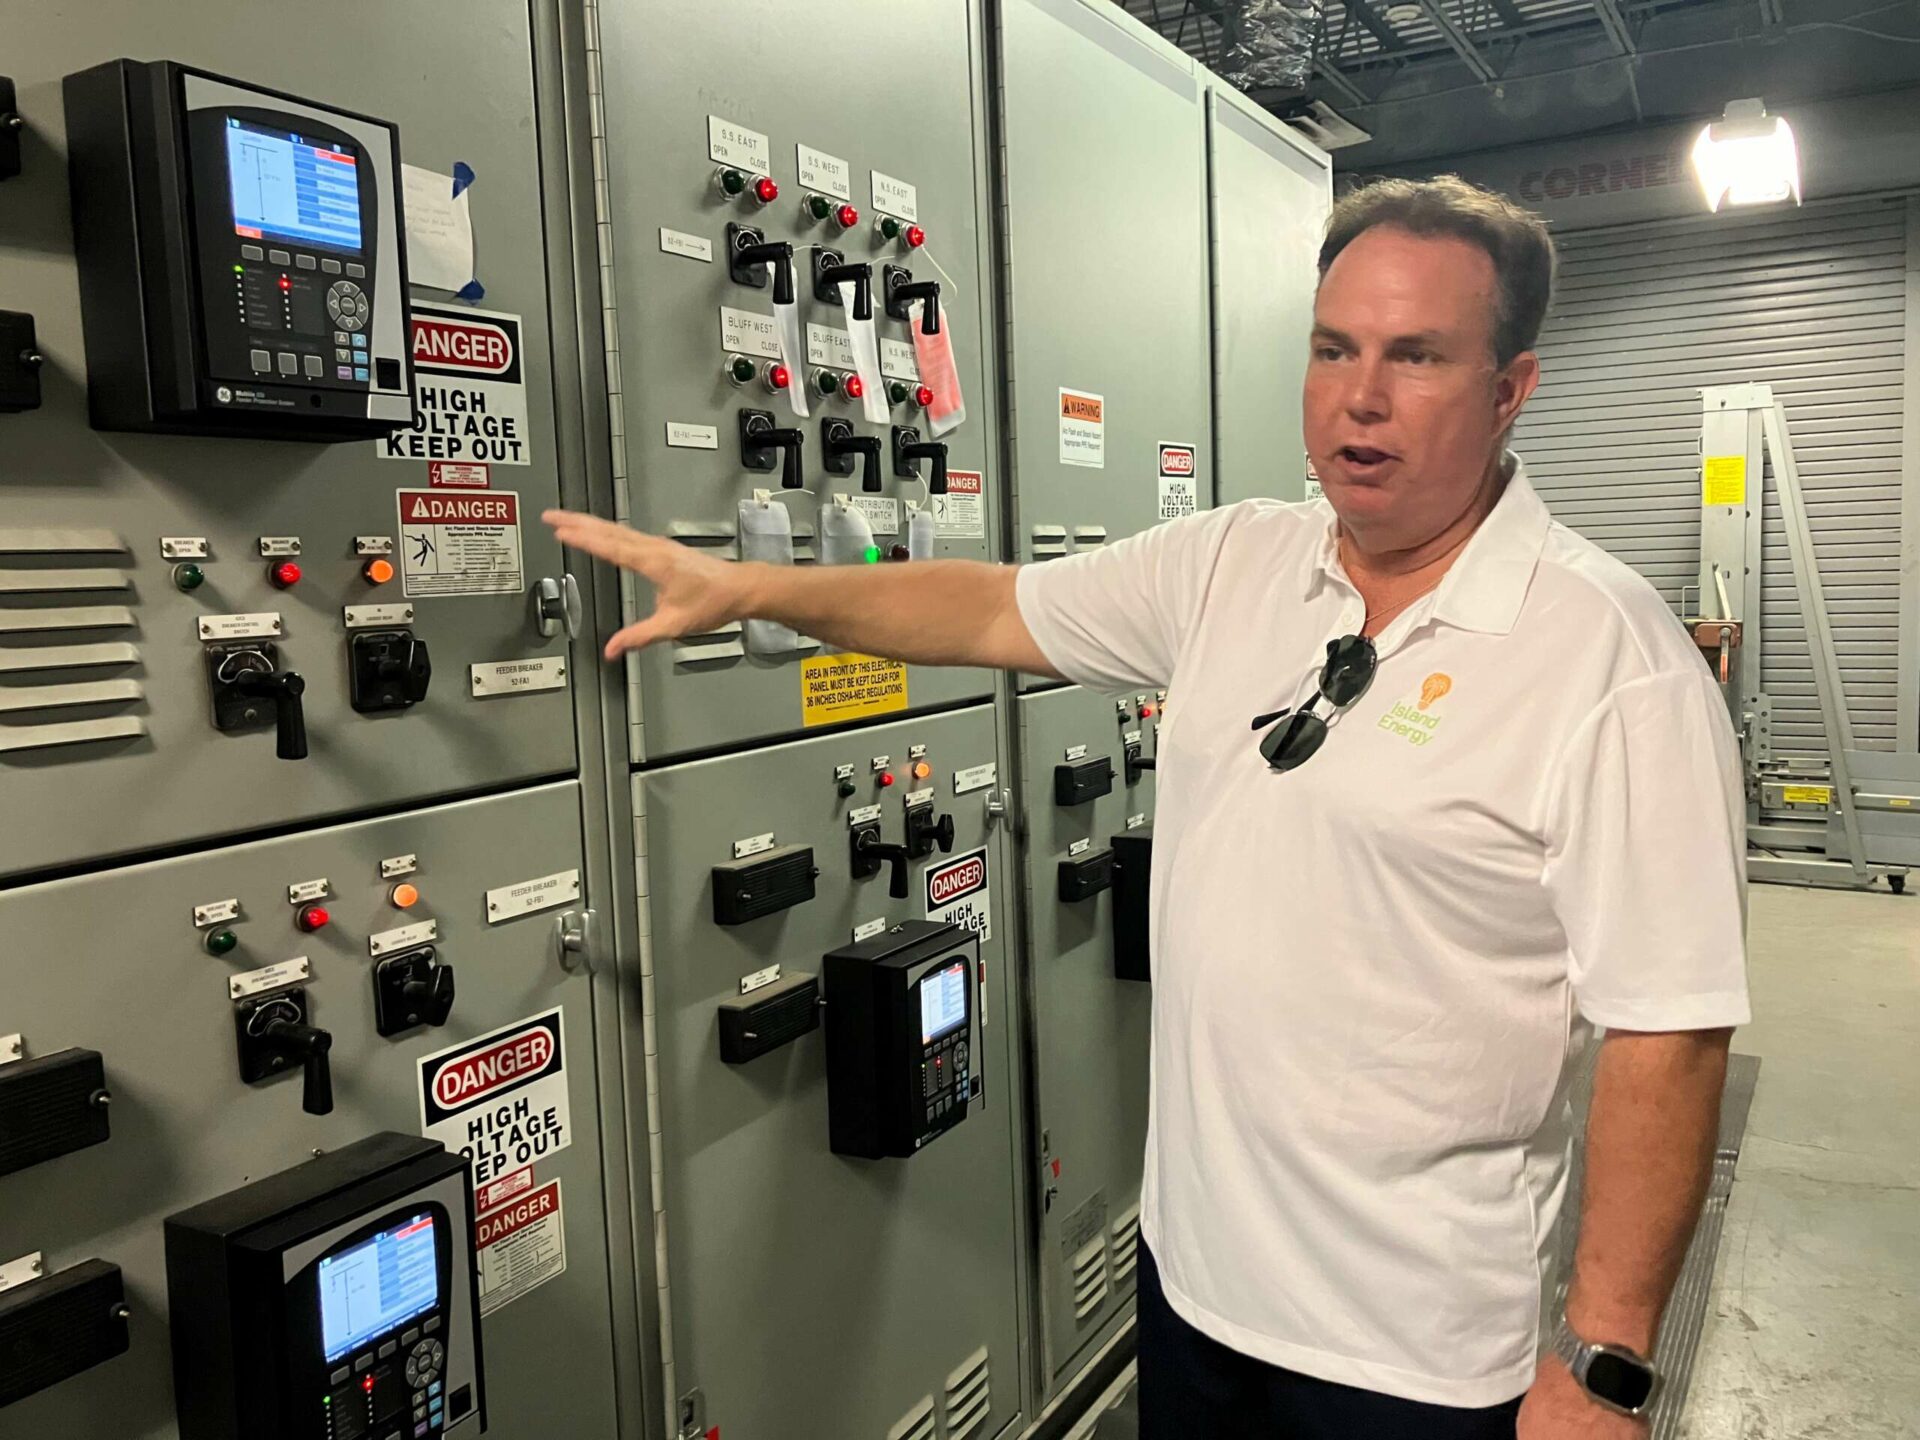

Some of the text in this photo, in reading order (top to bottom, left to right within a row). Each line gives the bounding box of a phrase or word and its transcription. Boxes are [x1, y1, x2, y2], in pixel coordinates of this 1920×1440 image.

[737, 134, 757, 149] EAST
[713, 144, 728, 157] OPEN
[750, 157, 767, 170] CLOSE
[822, 161, 840, 174] WEST
[801, 170, 814, 182] OPEN
[832, 181, 848, 193] CLOSE
[892, 186, 908, 198] EAST
[875, 195, 886, 206] OPEN
[901, 204, 915, 216] CLOSE
[728, 316, 773, 334] BLUFF WEST
[413, 327, 504, 364] ANGER
[726, 334, 740, 345] OPEN
[813, 332, 833, 344] BLUFF
[761, 341, 778, 352] CLOSE
[810, 348, 823, 358] OPEN
[883, 362, 894, 371] OPEN
[420, 387, 486, 413] HIGH
[1071, 401, 1100, 418] WARNING
[413, 411, 516, 438] OLTAGE
[387, 434, 522, 461] KEEP OUT
[1164, 454, 1191, 469] DANGER
[1169, 483, 1186, 494] HIGH
[1162, 495, 1193, 506] VOLTAGE
[431, 500, 508, 518] DANGER
[870, 511, 892, 520] SWITCH
[1161, 507, 1195, 517] KEEP OUT
[496, 663, 543, 674] FEEDER BREAKER
[805, 669, 822, 680] AREA
[822, 668, 829, 677] IN
[829, 665, 848, 676] FRONT
[849, 664, 858, 674] OF
[858, 662, 871, 672] THIS
[810, 672, 899, 693] PANEL MUST BE KEPT CLEAR FOR
[806, 696, 814, 707] 36
[815, 693, 836, 706] INCHES
[837, 689, 866, 702] OSHA-NEC
[867, 683, 903, 698] REGULATIONS
[1391, 700, 1441, 729] Island
[1377, 714, 1434, 746] Energy
[511, 879, 557, 897] FEEDER BREAKER
[934, 864, 980, 898] DANGER
[945, 903, 972, 923] HIGH
[442, 1036, 547, 1101] DANGER
[467, 1097, 529, 1141] HIGH
[459, 1106, 557, 1161] OLTAGE
[476, 1125, 563, 1185] EP OUT
[479, 1194, 551, 1243] DANGER
